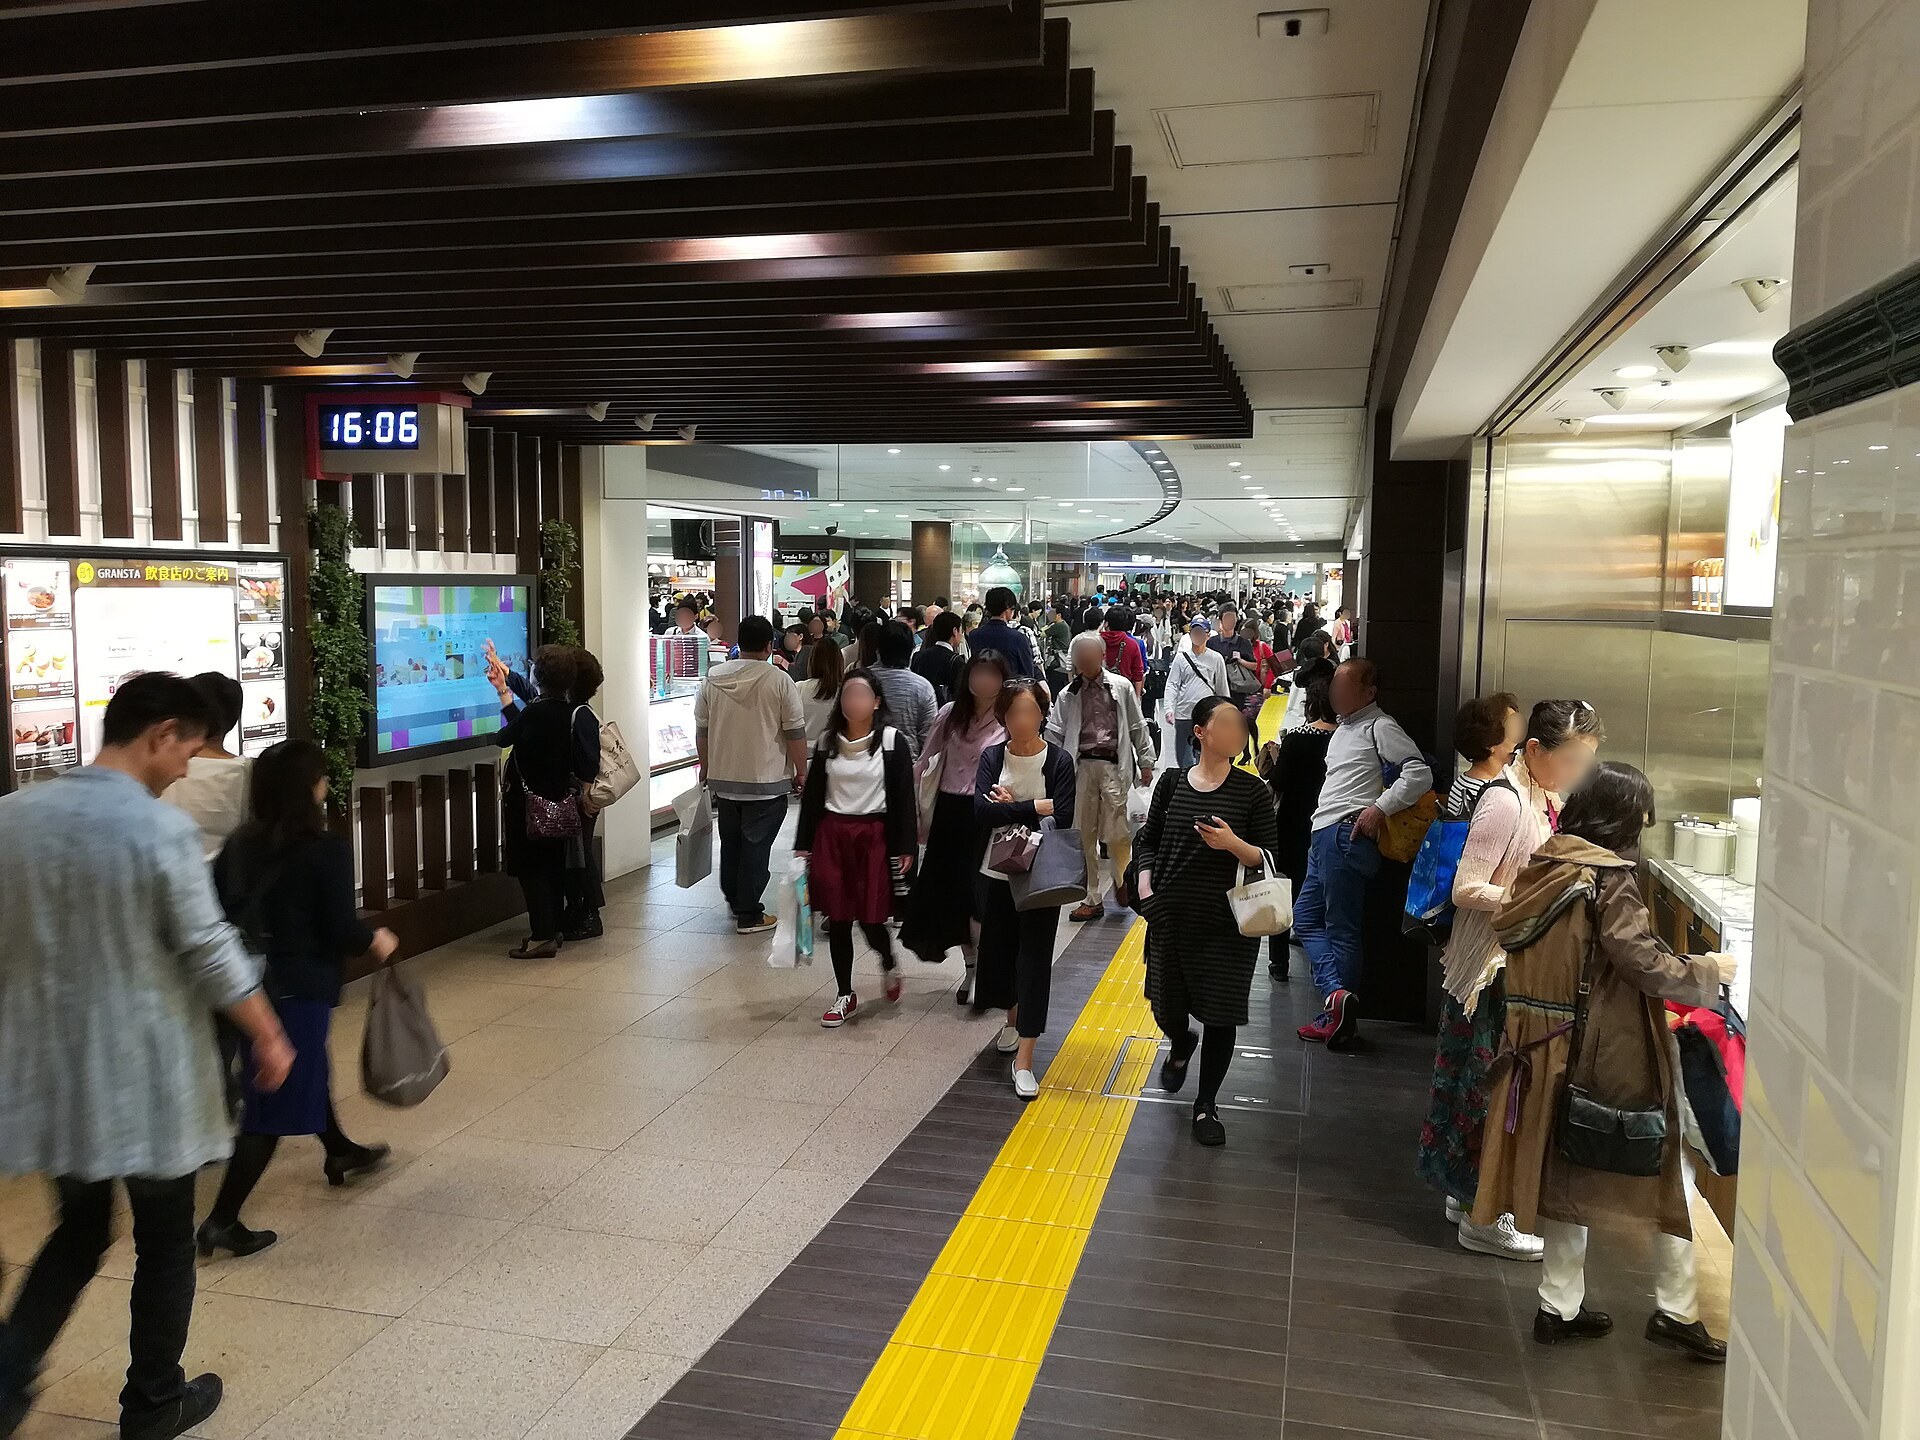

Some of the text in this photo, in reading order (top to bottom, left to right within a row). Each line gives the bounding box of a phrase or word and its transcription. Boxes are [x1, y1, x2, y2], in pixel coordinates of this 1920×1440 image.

[333, 412, 418, 443] 16:06
[97, 568, 141, 579] GRANSTA
[145, 565, 229, 582] 飲食店のご案内
